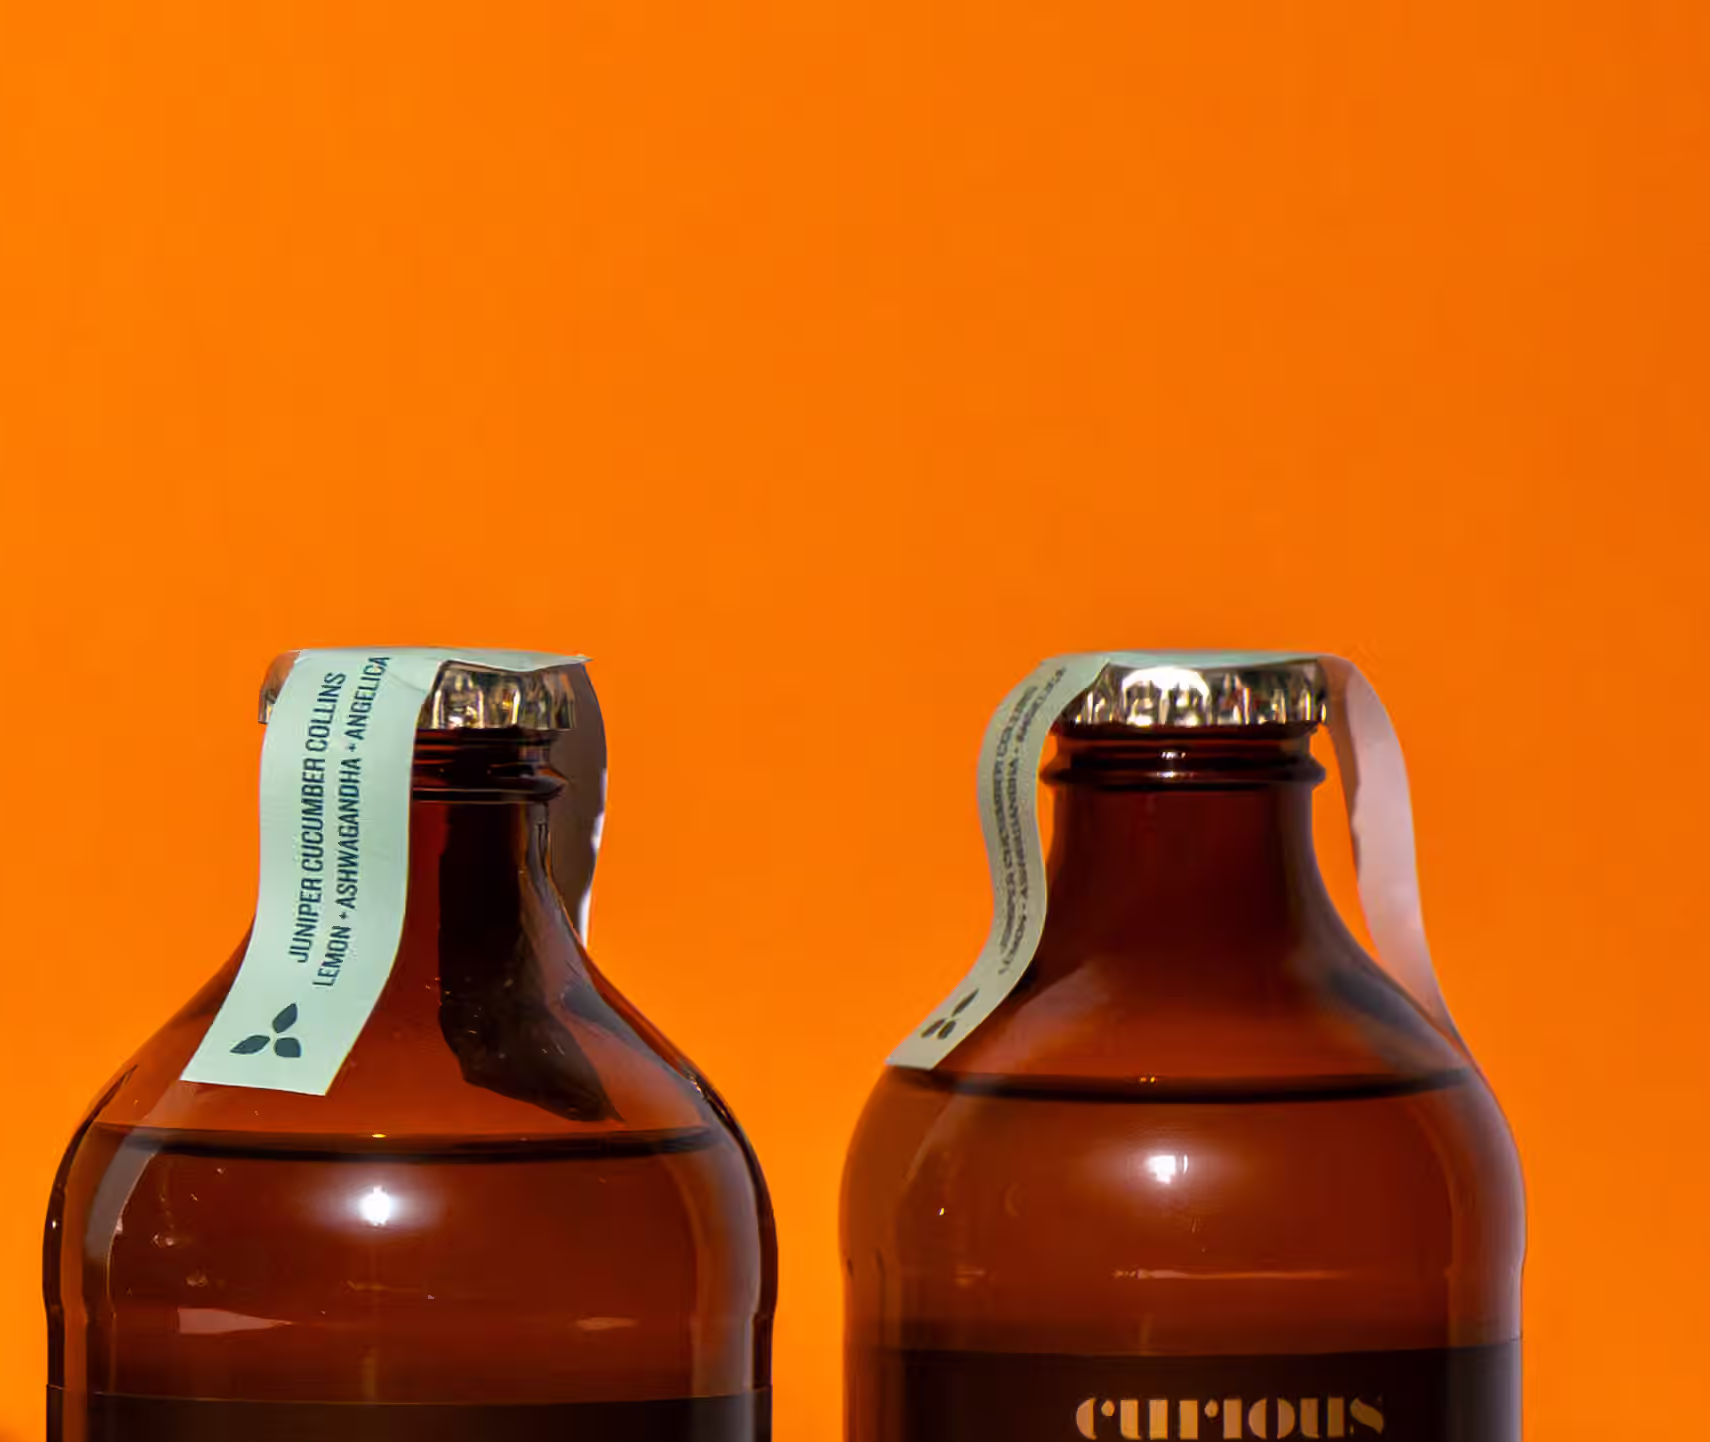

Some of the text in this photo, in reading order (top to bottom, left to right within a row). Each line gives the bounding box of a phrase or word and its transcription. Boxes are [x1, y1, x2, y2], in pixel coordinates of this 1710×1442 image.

[344, 654, 391, 741] ANGELICA
[287, 671, 347, 964] JUNIPER CUCUMBER COLLINS
[336, 757, 362, 910] ASHWAGANDHA
[312, 925, 352, 988] LEMON
[1076, 1397, 1385, 1441] curious
